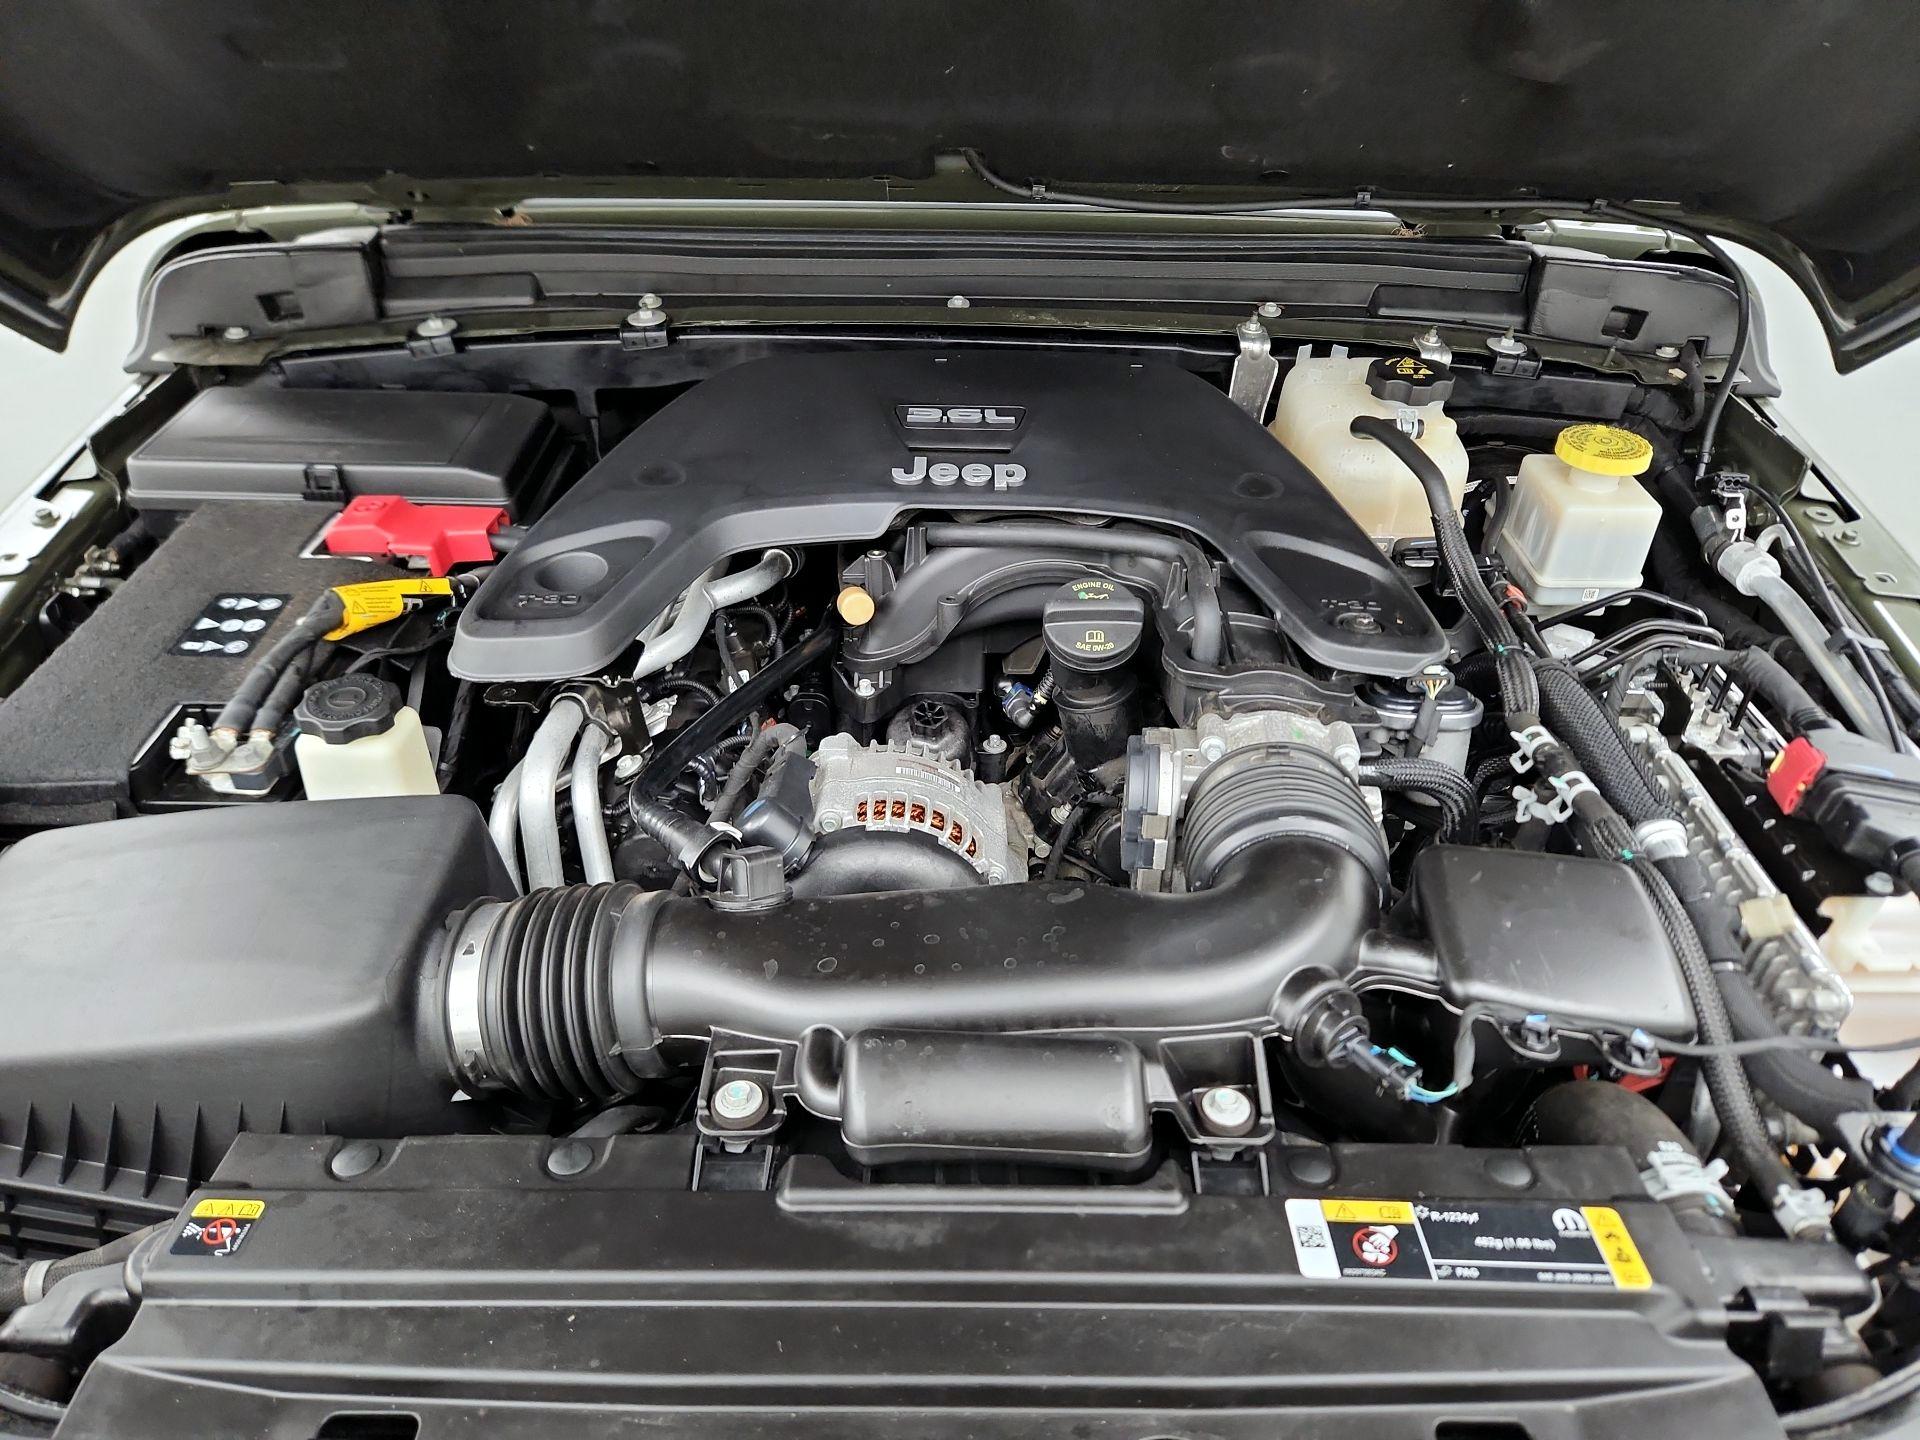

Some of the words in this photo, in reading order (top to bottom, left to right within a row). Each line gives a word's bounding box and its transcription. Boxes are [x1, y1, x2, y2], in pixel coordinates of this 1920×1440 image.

[906, 408, 1016, 424] 3.6L
[891, 456, 1027, 491] Jeep
[1071, 581, 1101, 592] ENGINE
[1102, 582, 1115, 592] OIL
[1075, 641, 1091, 651] SAE
[1092, 642, 1115, 652] 0W-20
